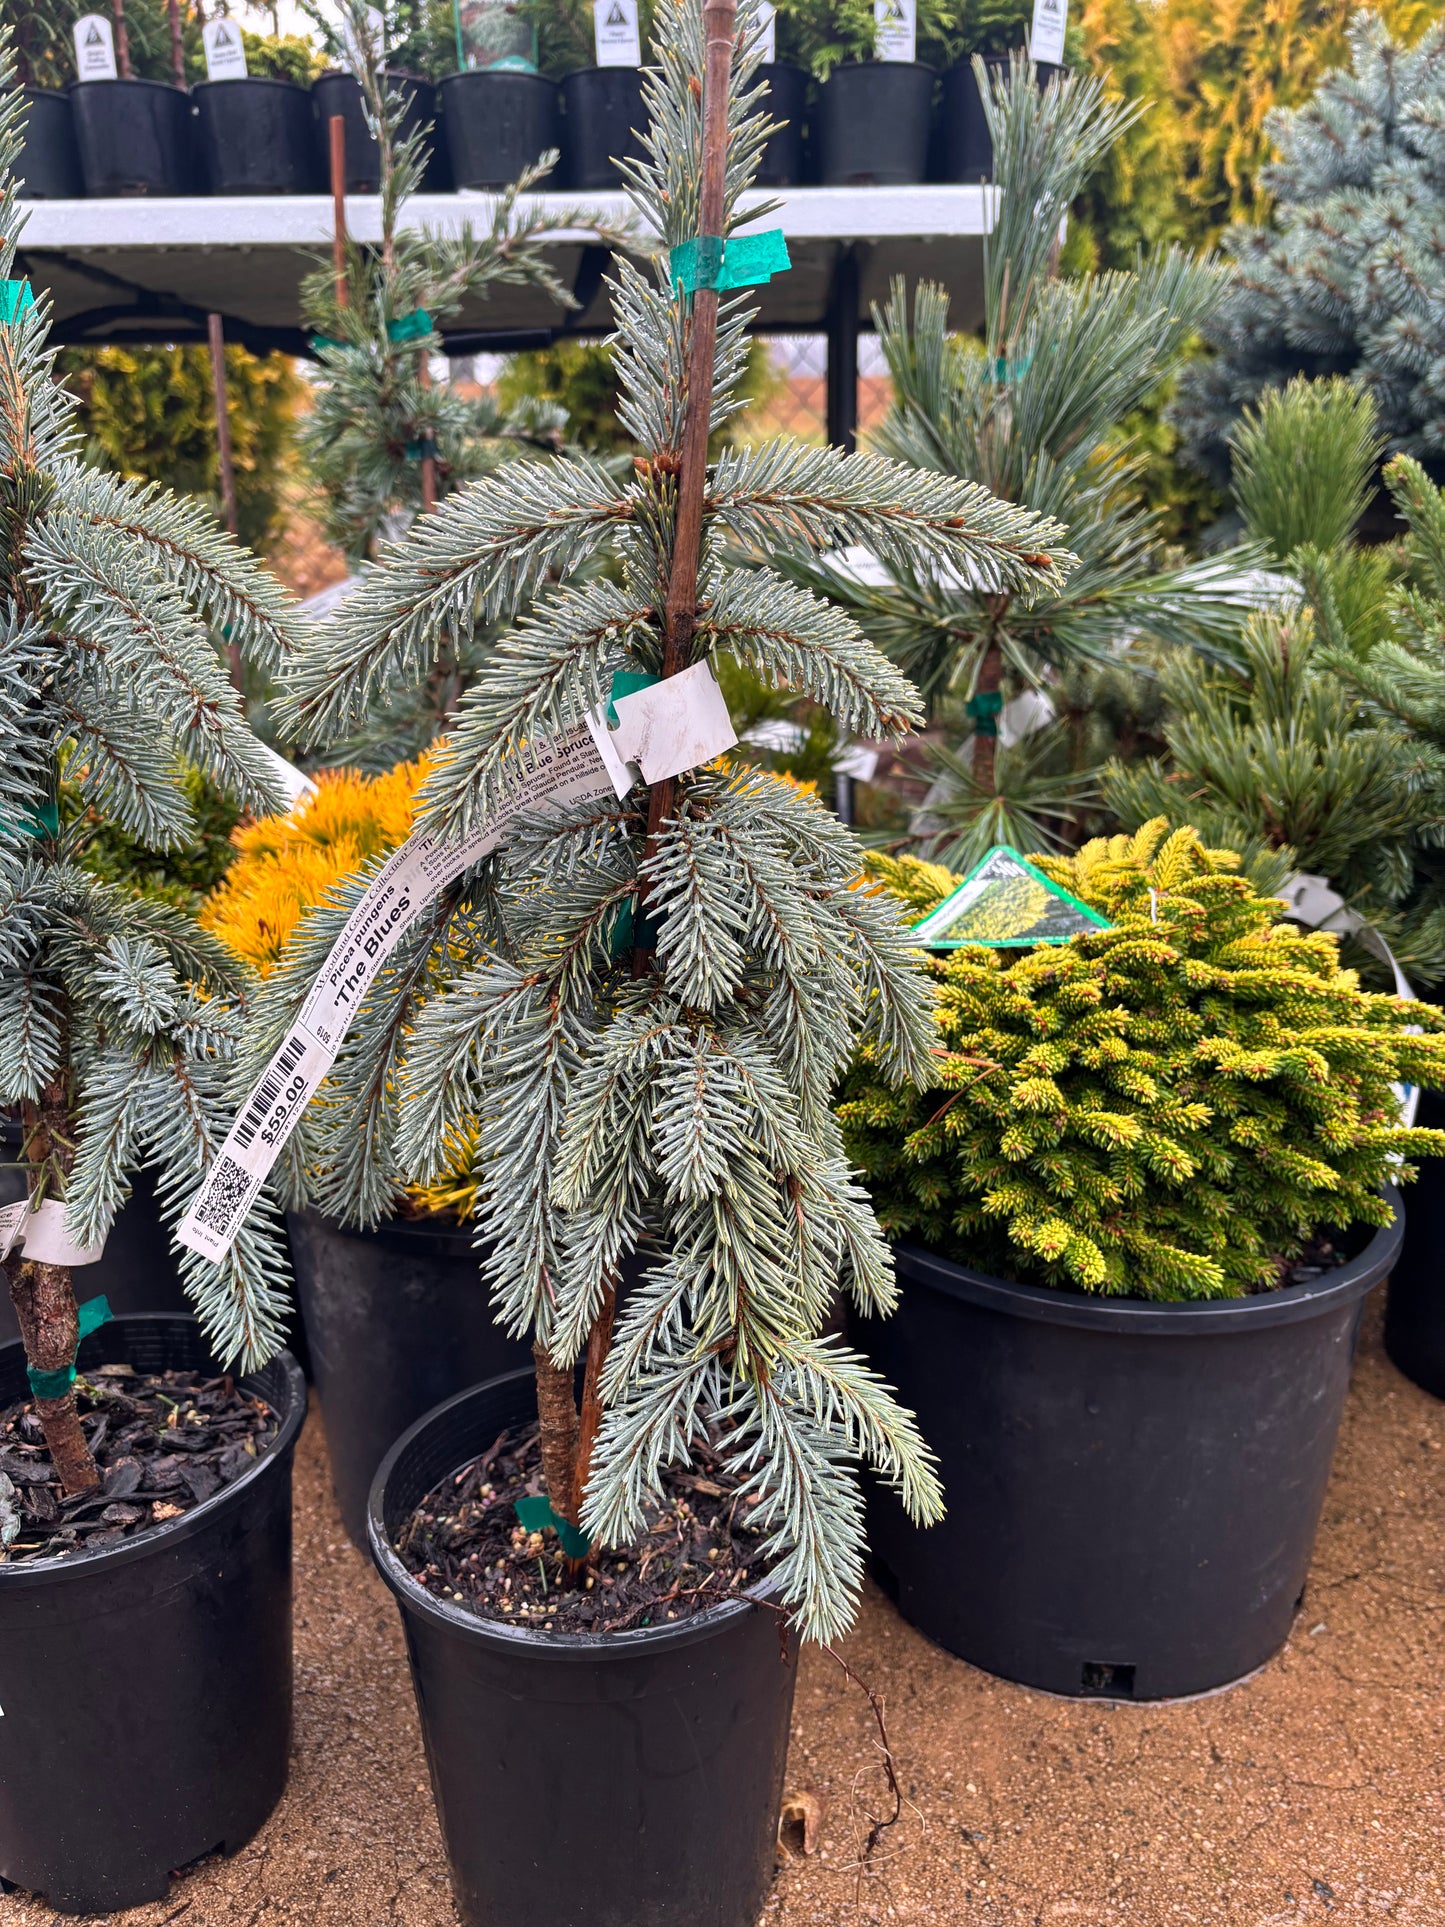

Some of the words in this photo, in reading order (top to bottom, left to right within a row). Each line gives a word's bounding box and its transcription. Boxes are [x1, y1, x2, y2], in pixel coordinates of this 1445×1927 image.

[538, 741, 546, 749] &
[547, 758, 571, 774] Found
[418, 836, 436, 853] 'Th
[526, 755, 552, 774] Bue
[427, 850, 444, 866] Sons
[514, 792, 523, 801] of
[528, 775, 555, 793] 'Glauca
[432, 861, 441, 870] be
[494, 807, 513, 822] ooks
[514, 796, 532, 812] great
[532, 782, 558, 801] planted
[558, 779, 569, 787] on
[574, 765, 599, 780] hillside
[348, 902, 370, 932] Gems
[369, 846, 408, 900] Collection"
[400, 910, 416, 930] Shape
[419, 882, 441, 905] Upright
[439, 861, 466, 883] Weeper
[429, 868, 444, 882] over
[442, 853, 461, 869] rocks
[329, 946, 355, 987] Picea
[354, 884, 395, 946] pungens
[334, 961, 366, 1006] 'The
[364, 886, 410, 958] Blues'
[316, 1025, 332, 1044] 5019
[329, 1044, 337, 1054] 10
[333, 1024, 346, 1044] Year
[349, 999, 357, 1010] W
[369, 947, 387, 973] Staked
[261, 1076, 305, 1144] $59.00
[274, 1131, 285, 1145] Pot
[192, 1227, 203, 1237] Info
[204, 1233, 220, 1247] Plant
